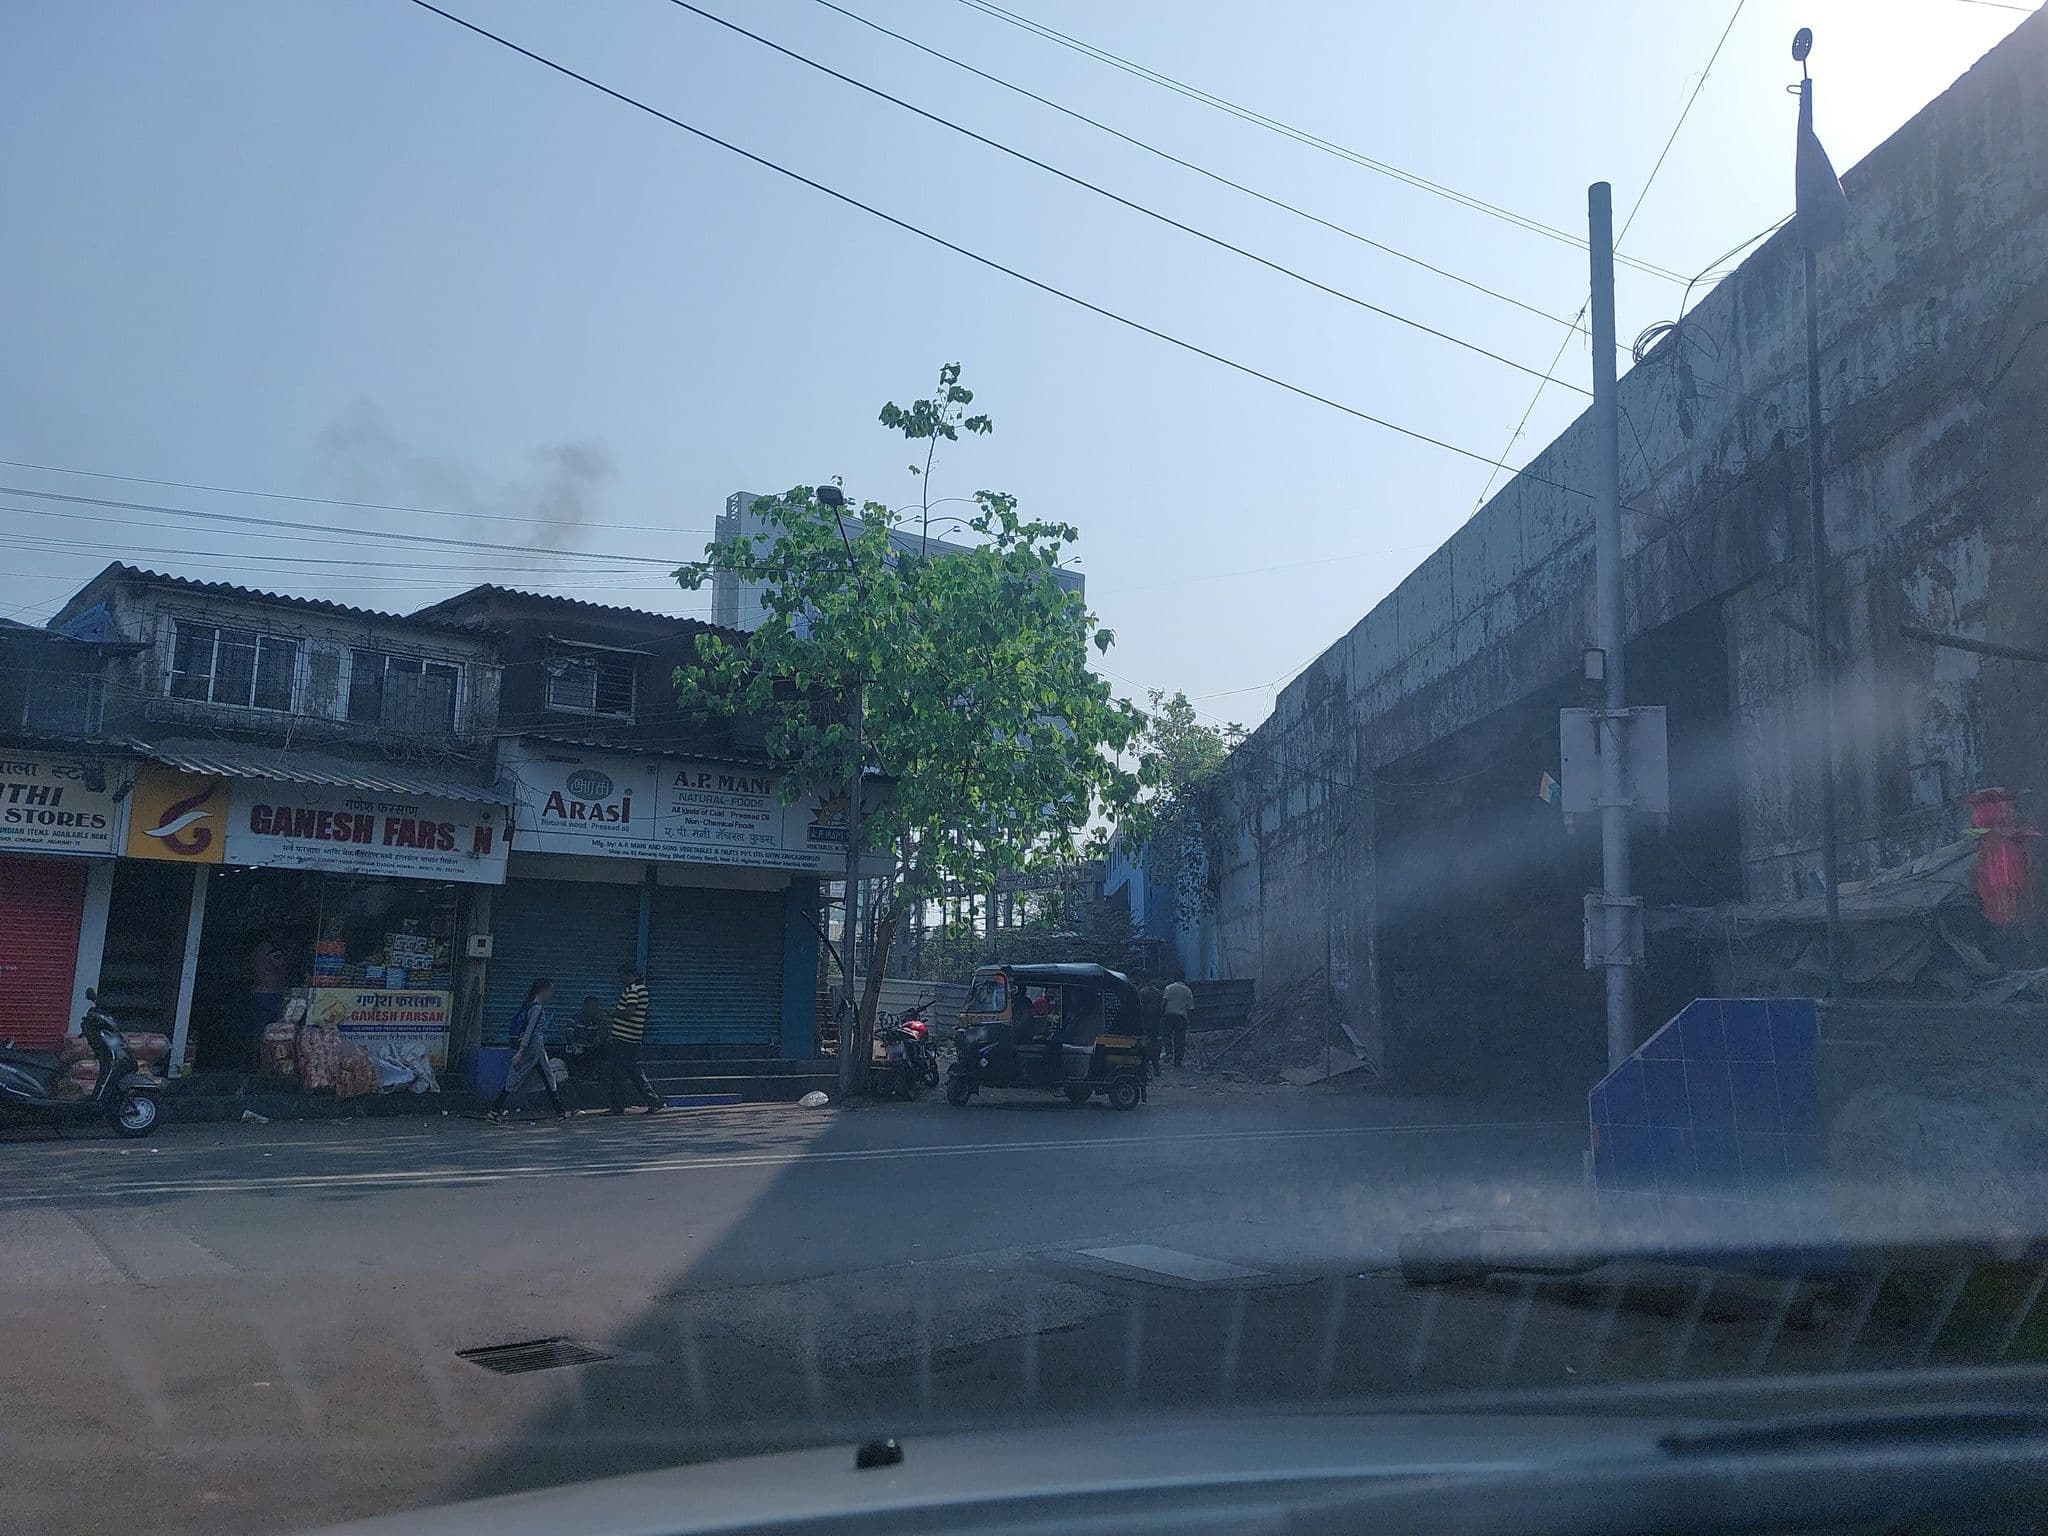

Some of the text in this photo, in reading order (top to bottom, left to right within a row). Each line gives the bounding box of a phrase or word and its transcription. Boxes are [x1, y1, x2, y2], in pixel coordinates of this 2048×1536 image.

[673, 771, 772, 795] A.P. MANI
[344, 796, 419, 817] गणेश फरसाण
[671, 806, 681, 814] All
[709, 809, 725, 817] Cold
[5, 808, 106, 829] STORES
[250, 803, 374, 845] GANESH
[568, 821, 587, 829] wood
[735, 821, 755, 829] Foods
[356, 993, 392, 1008] गणेश
[351, 1010, 444, 1023] GANESH FARSAN
